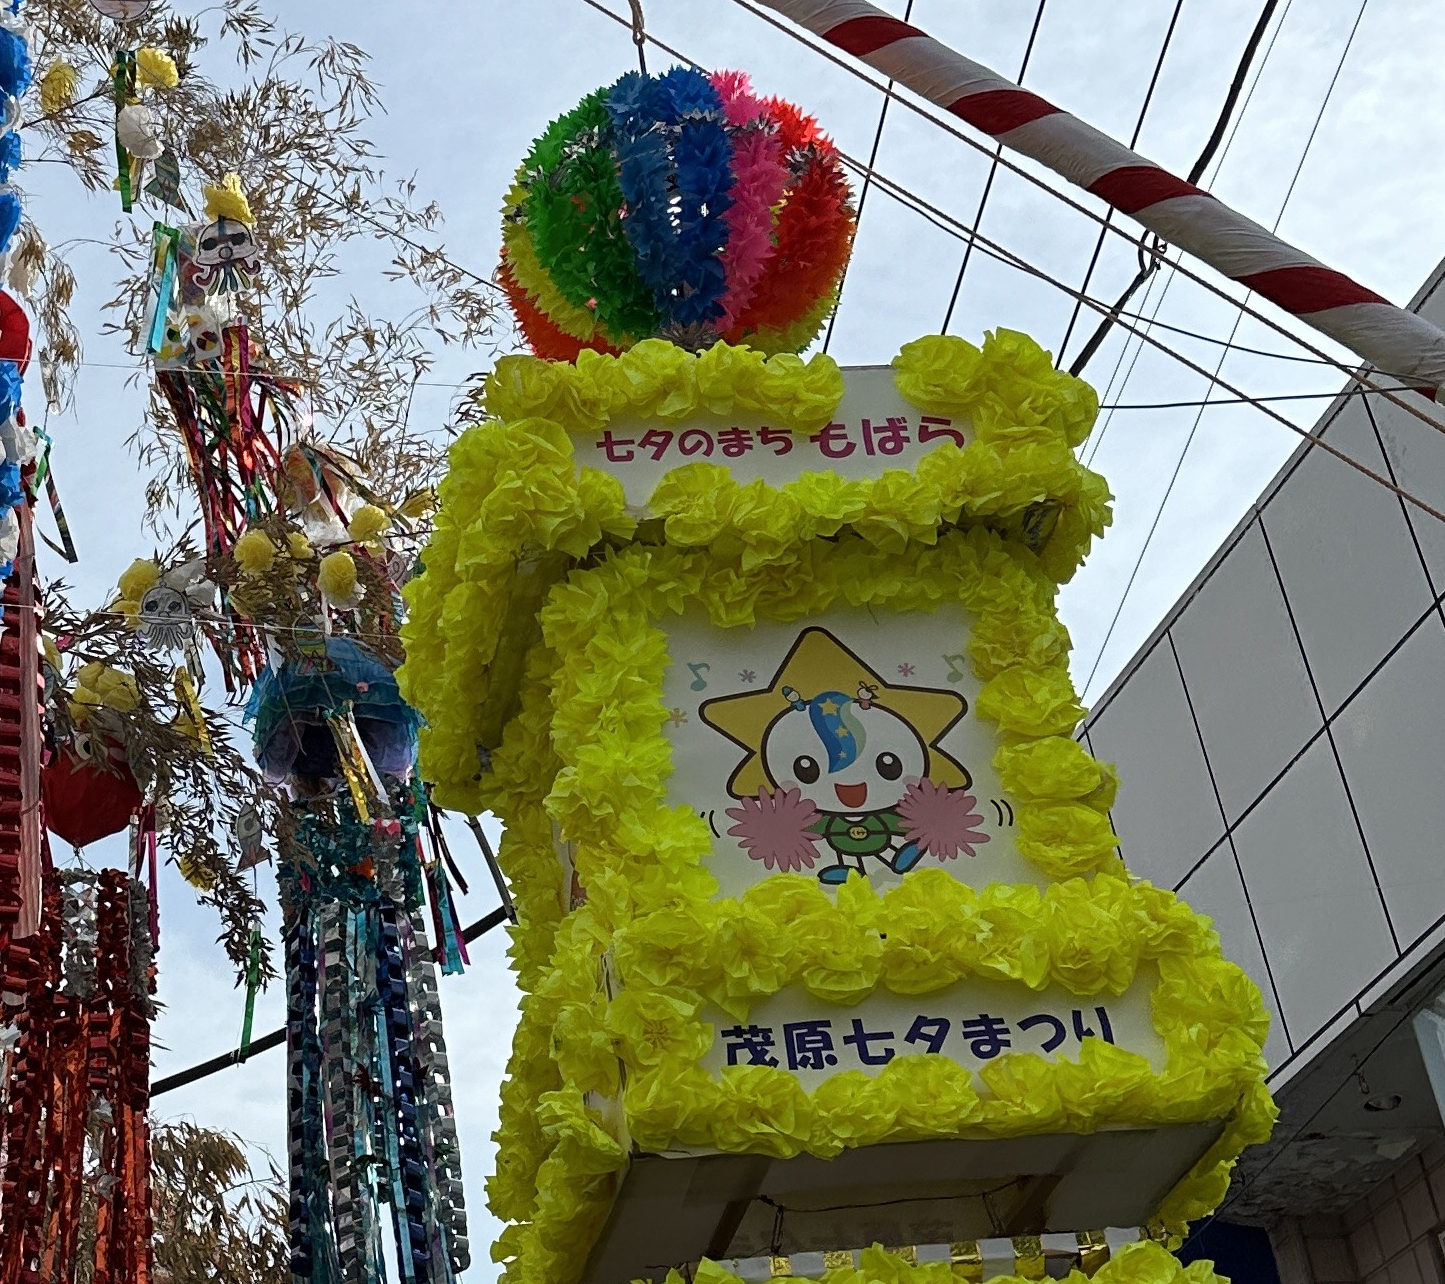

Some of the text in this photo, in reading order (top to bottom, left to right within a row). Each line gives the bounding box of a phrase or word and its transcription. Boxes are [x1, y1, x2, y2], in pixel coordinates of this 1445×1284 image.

[596, 416, 966, 463] 七夕のまち もばら
[720, 1005, 1116, 1071] 茂原七夕まつり
